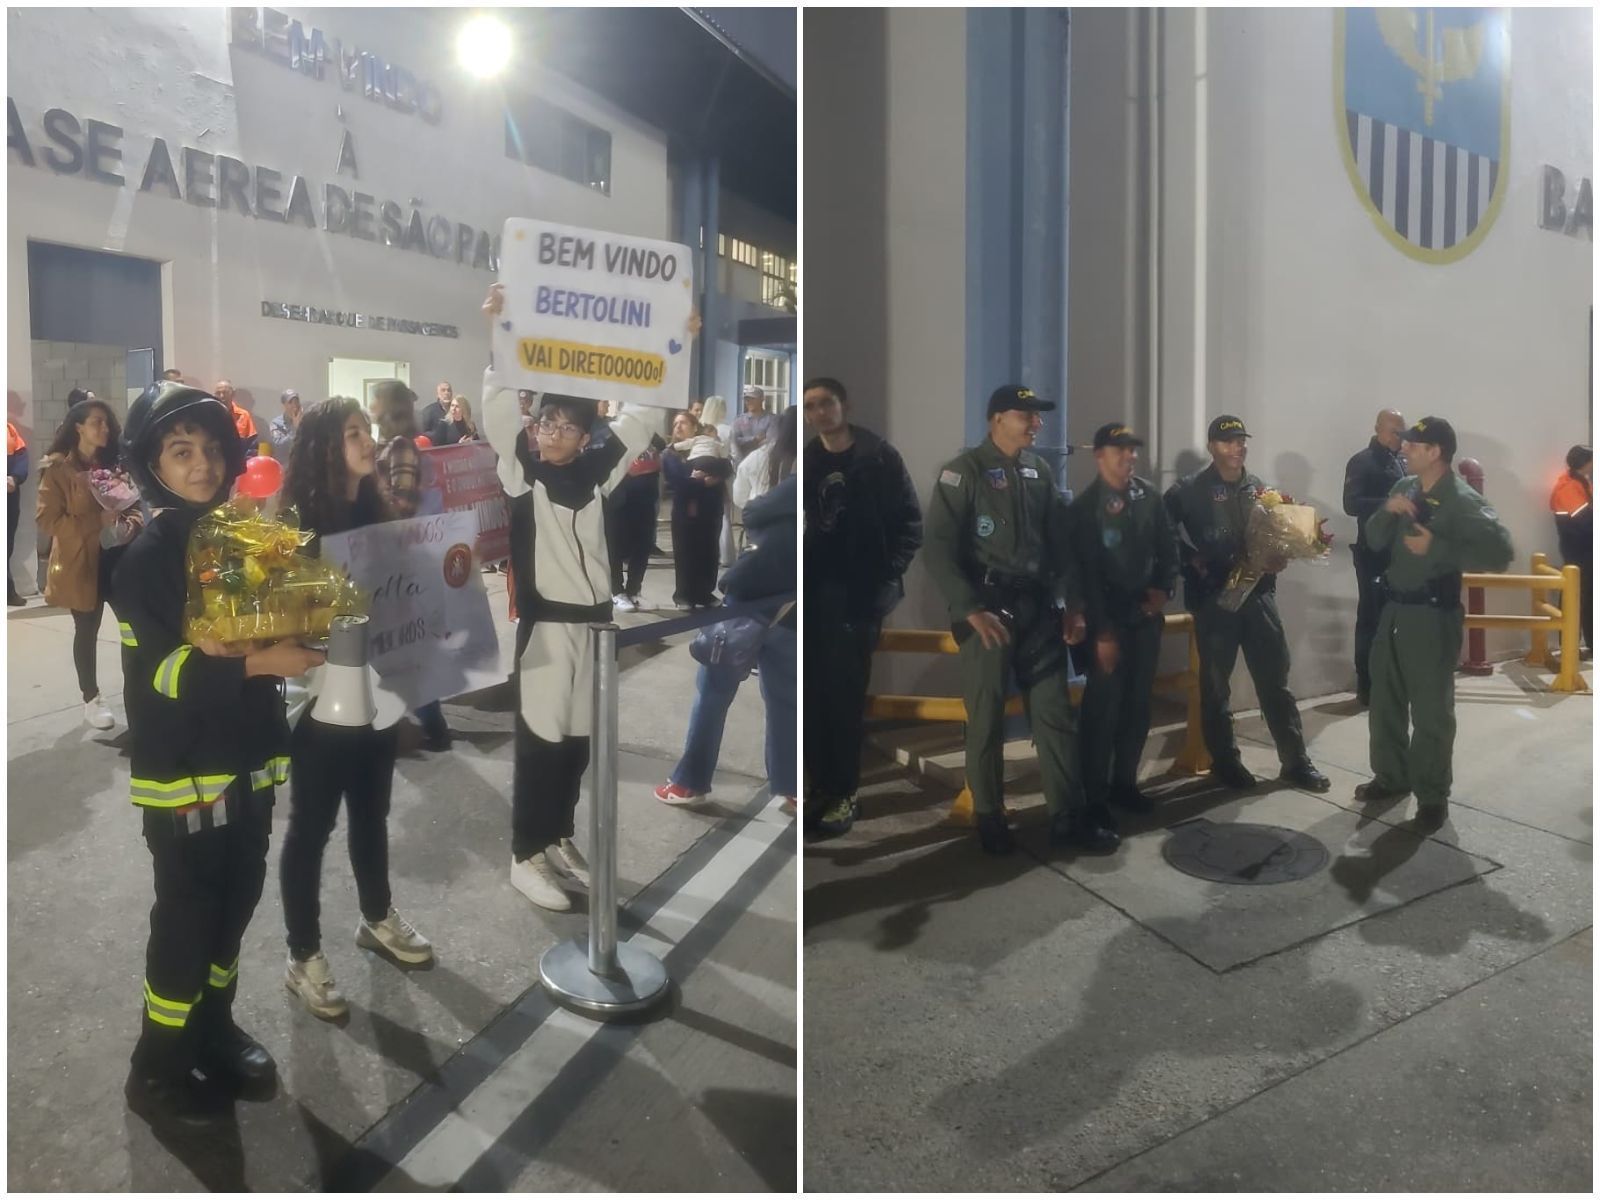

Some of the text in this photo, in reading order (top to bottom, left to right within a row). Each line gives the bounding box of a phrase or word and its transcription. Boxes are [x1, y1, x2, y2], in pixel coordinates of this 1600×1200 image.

[334, 38, 441, 124] VINDO
[322, 181, 376, 243] DE
[379, 195, 454, 259] SÃO
[538, 233, 678, 282] BEM VINDO
[535, 285, 651, 329] BERTOLINI
[522, 343, 553, 369] VAI
